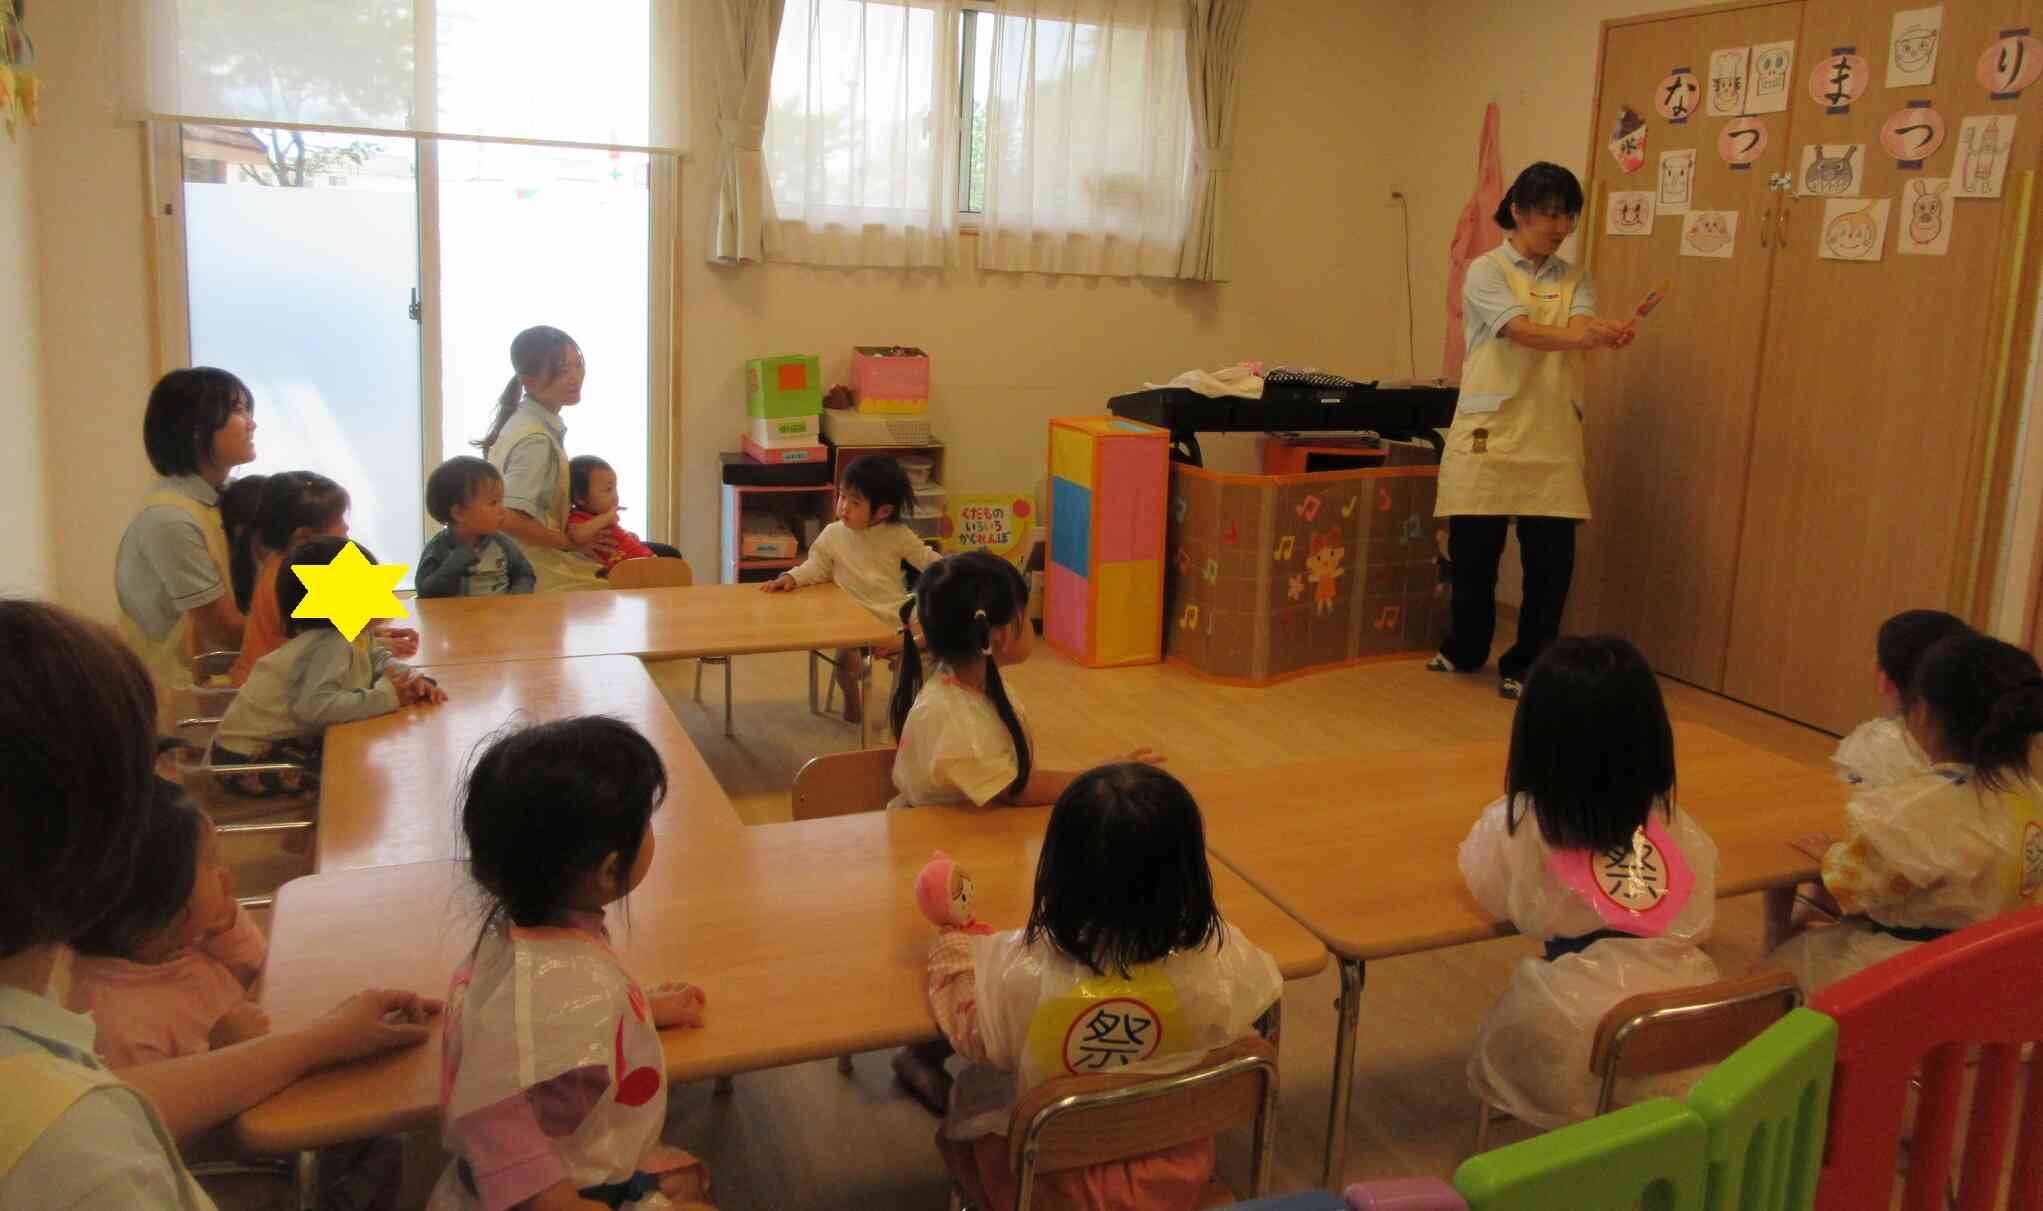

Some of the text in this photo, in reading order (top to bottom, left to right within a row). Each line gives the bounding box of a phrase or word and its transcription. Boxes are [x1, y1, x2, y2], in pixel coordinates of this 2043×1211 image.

[1824, 55, 1852, 105] ま
[1998, 39, 2024, 90] り
[1664, 76, 1697, 117] な
[1727, 128, 1761, 153] つ
[1894, 123, 1935, 150] つ
[962, 507, 1004, 520] くだもの
[1072, 1008, 1152, 1069] 祭
